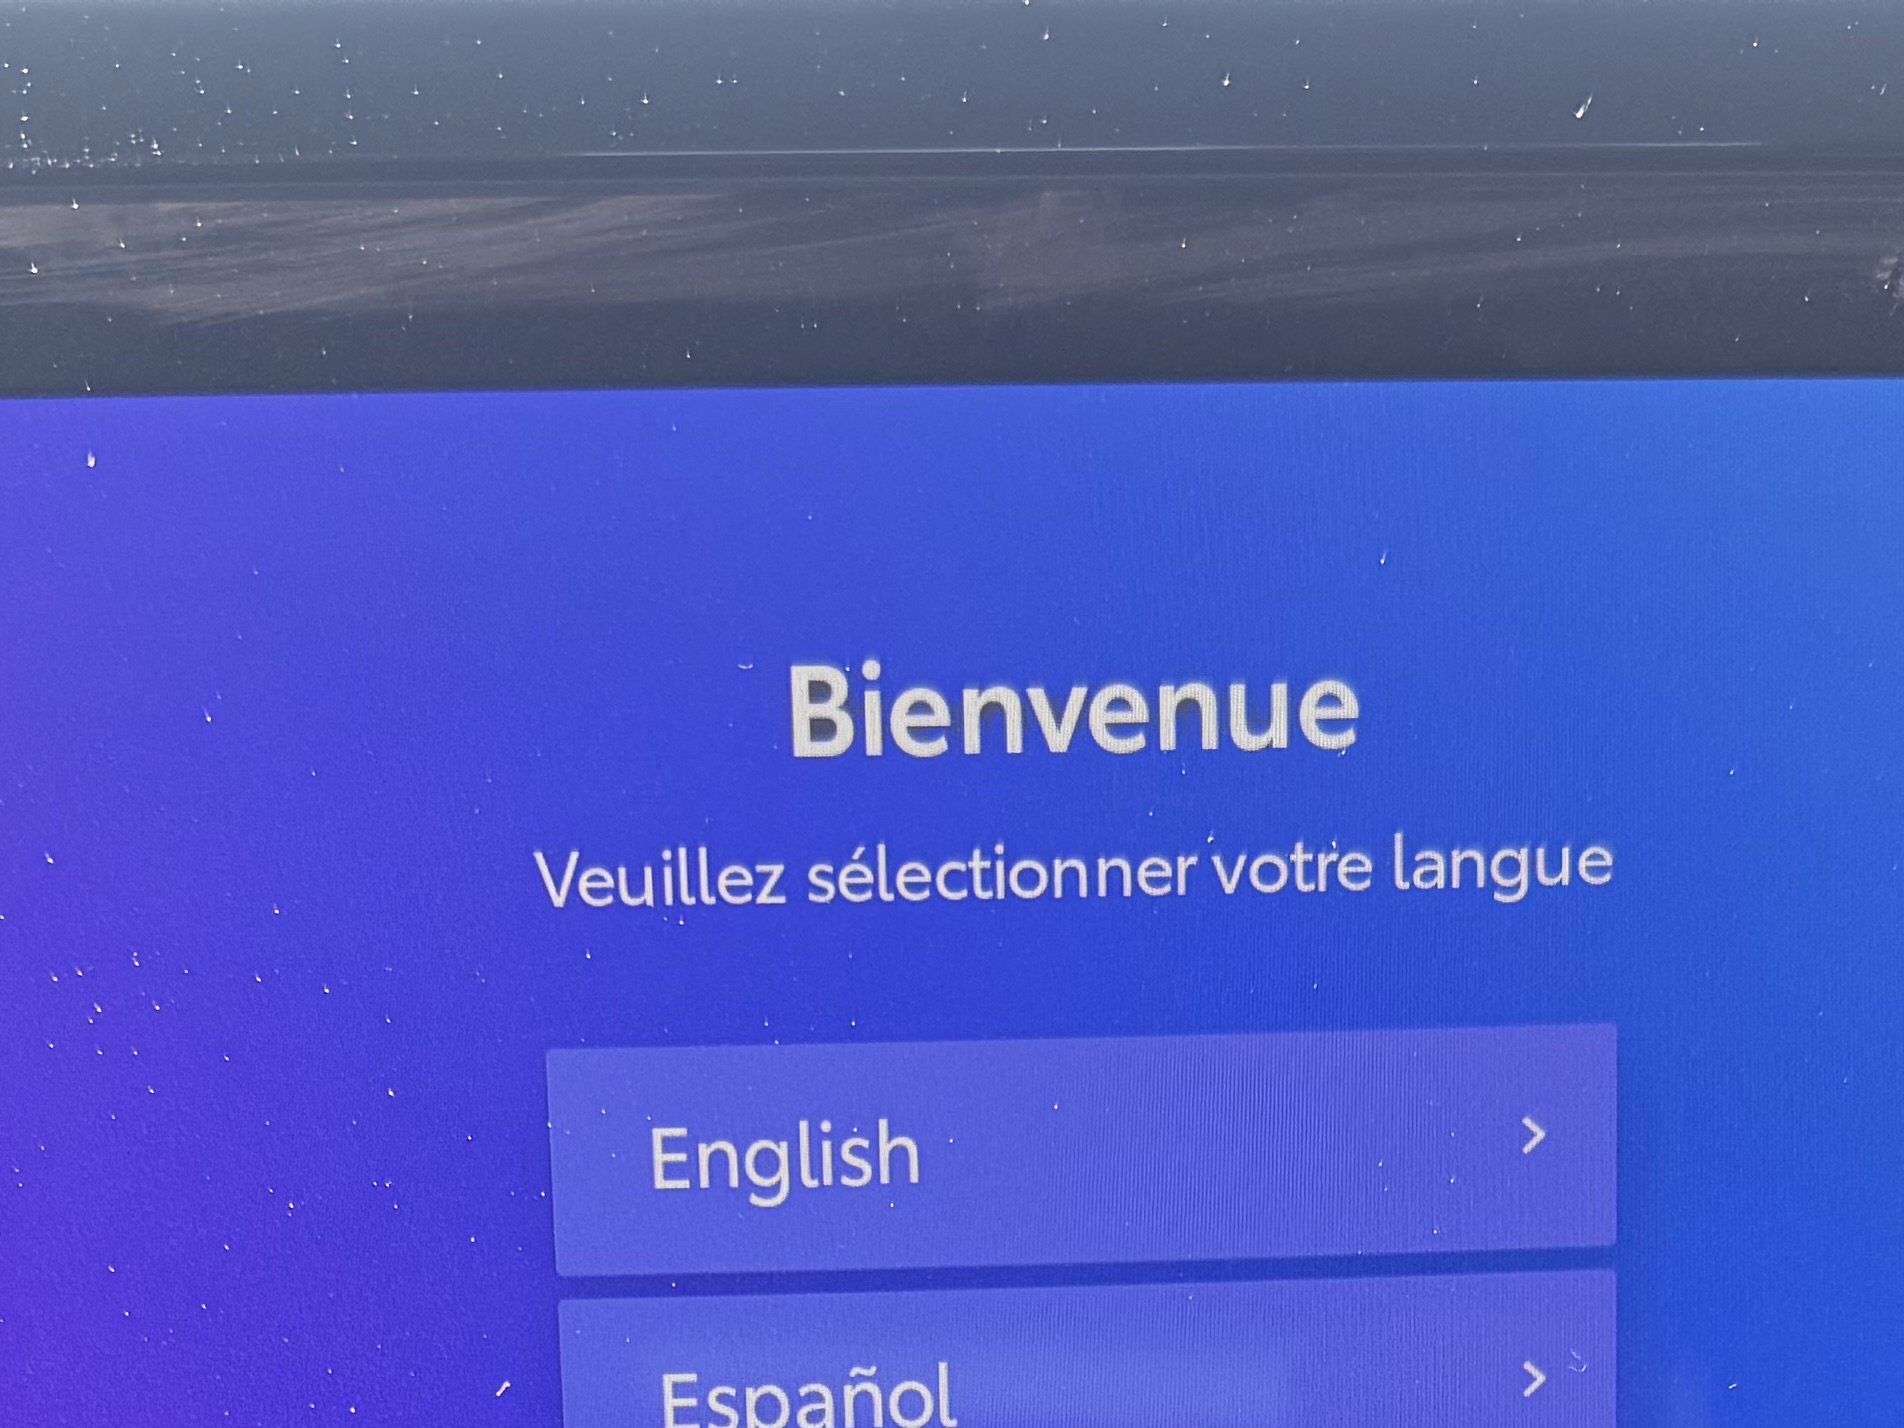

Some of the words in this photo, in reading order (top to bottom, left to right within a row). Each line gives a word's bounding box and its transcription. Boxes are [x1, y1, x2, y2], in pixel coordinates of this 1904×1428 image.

[789, 660, 1360, 759] Bienvenue
[533, 847, 787, 909] Veuillez
[807, 840, 1199, 904] sélectionner
[1211, 840, 1373, 895] votre
[1394, 832, 1613, 904] langue
[650, 1118, 922, 1208] English
